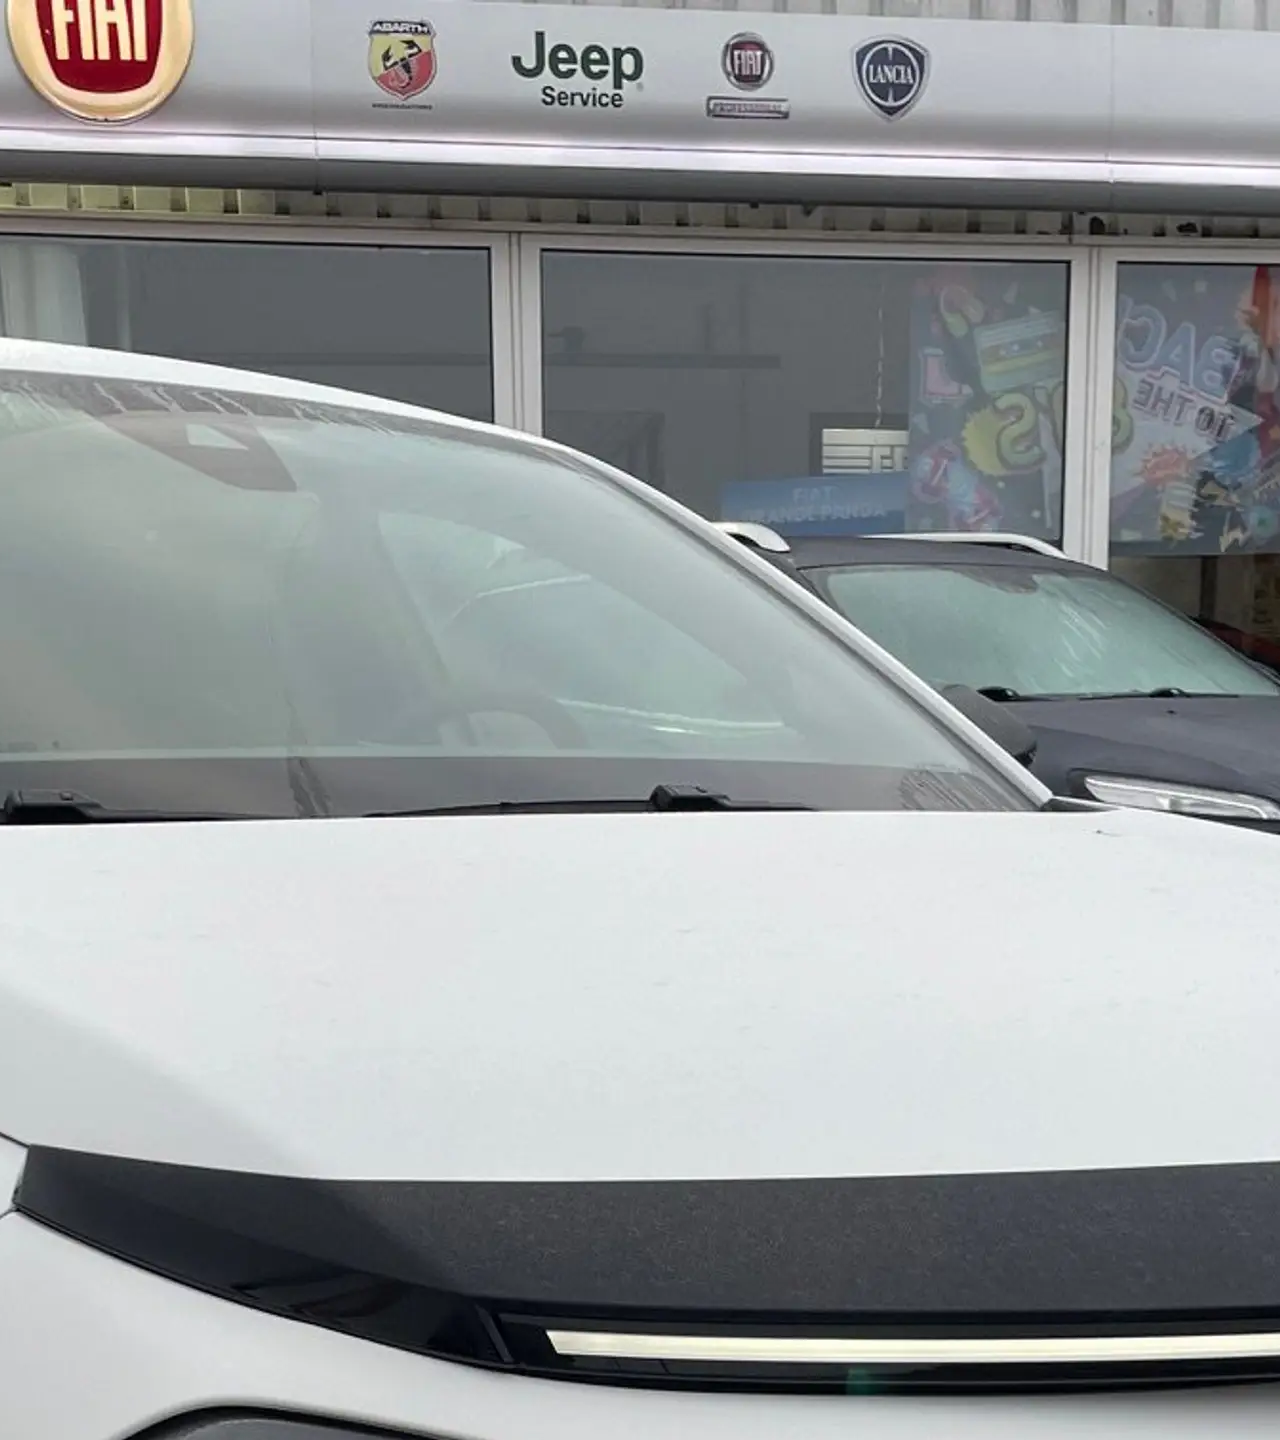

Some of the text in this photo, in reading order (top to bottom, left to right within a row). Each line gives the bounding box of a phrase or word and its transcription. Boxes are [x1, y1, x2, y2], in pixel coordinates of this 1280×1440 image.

[51, 0, 148, 61] FIAT
[372, 22, 430, 34] ABARTH
[511, 30, 644, 89] Jeep
[733, 49, 764, 76] FIAT
[869, 64, 914, 85] LANCIA
[541, 86, 625, 108] Service
